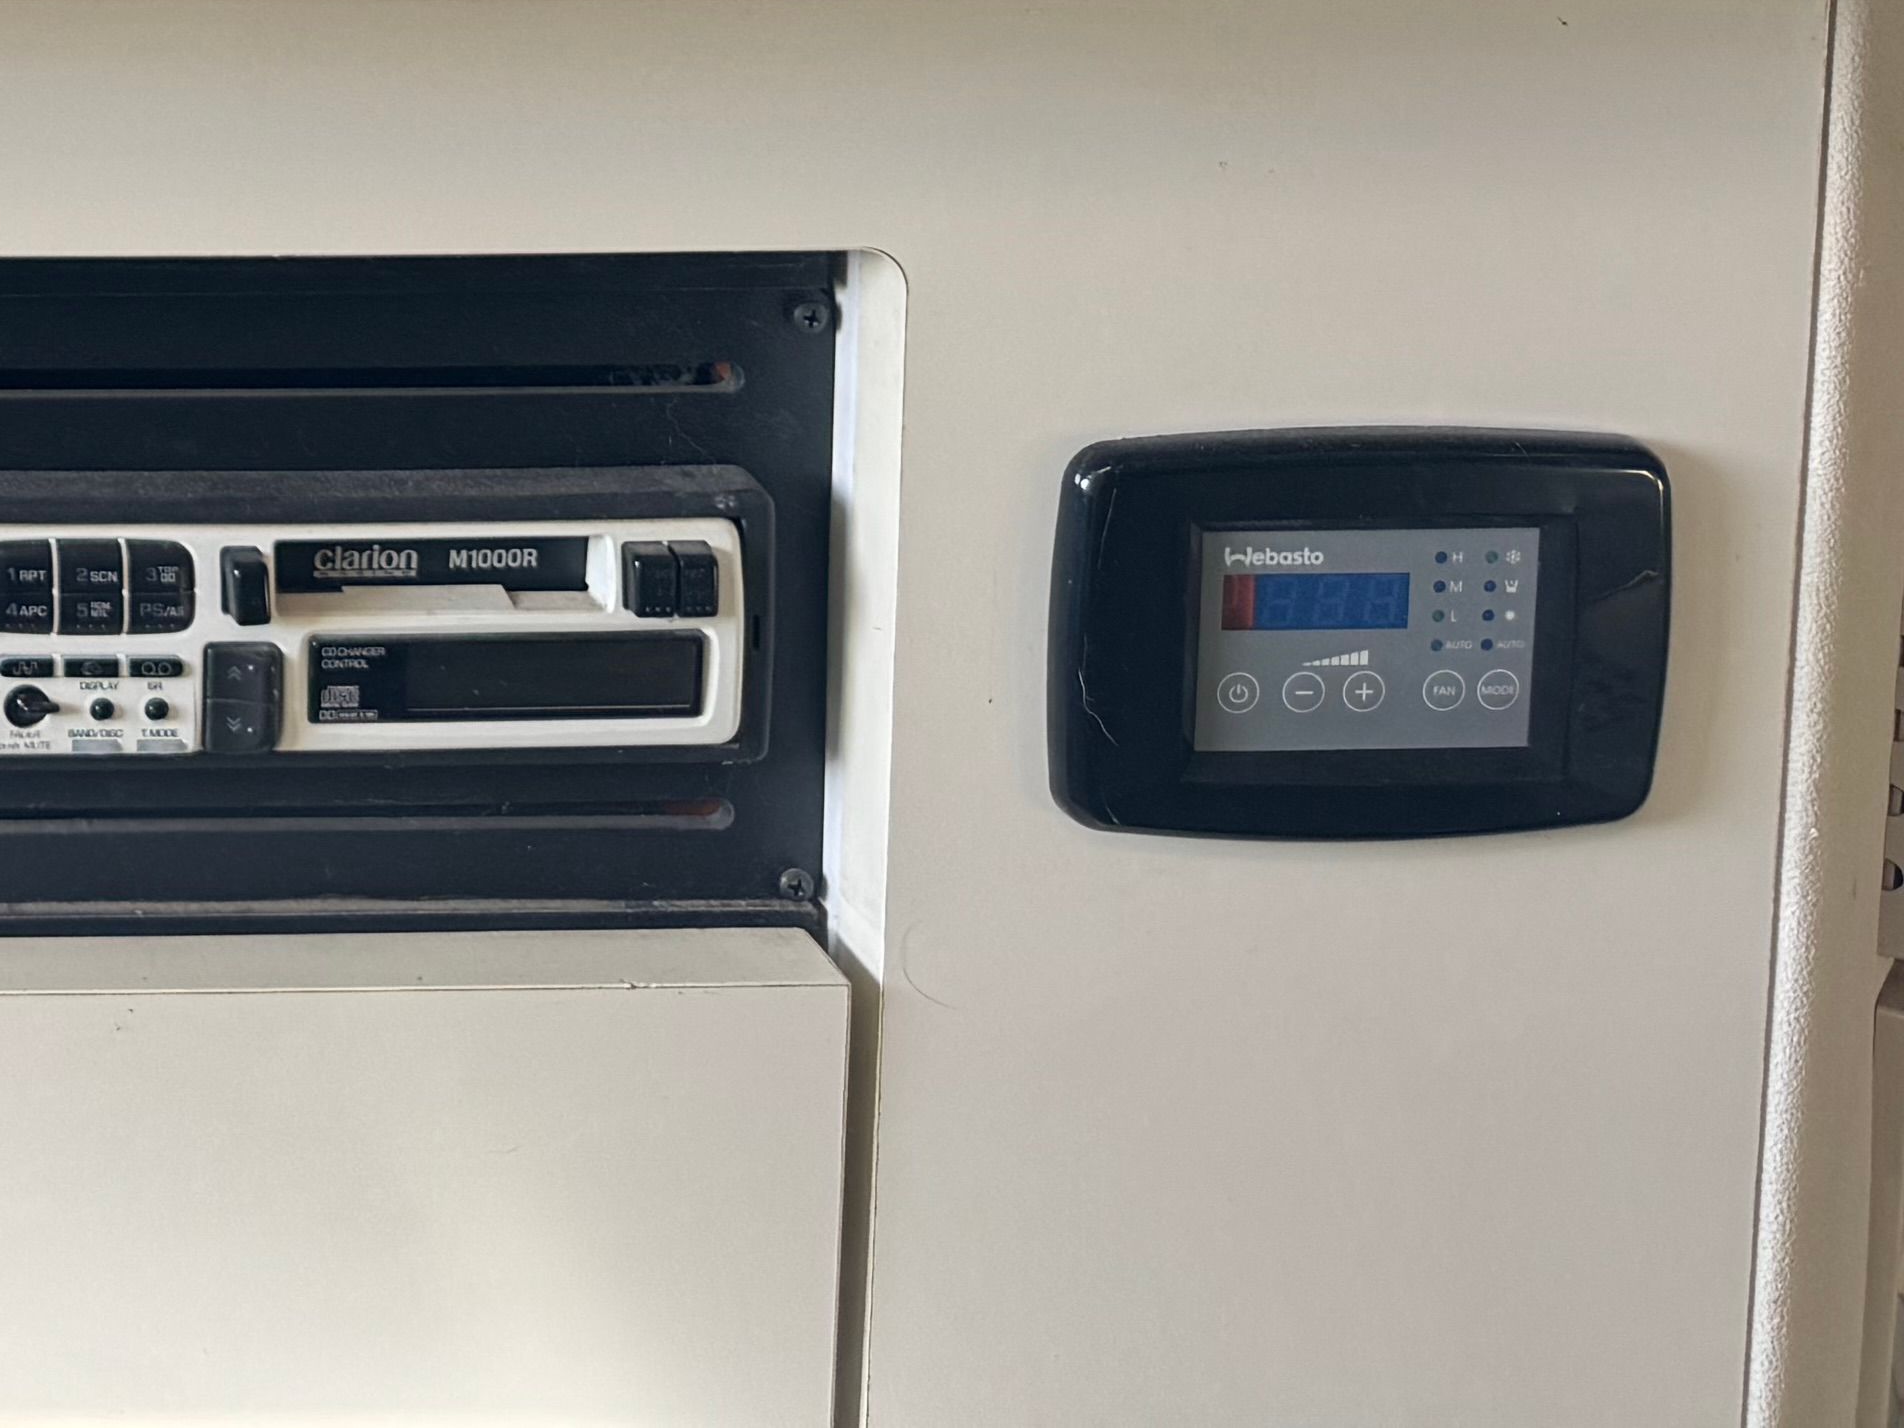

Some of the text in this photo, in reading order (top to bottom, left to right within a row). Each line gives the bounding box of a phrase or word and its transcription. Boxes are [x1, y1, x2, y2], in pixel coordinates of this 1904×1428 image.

[313, 545, 538, 571] clarion M1000R
[1225, 546, 1324, 566] Webasto
